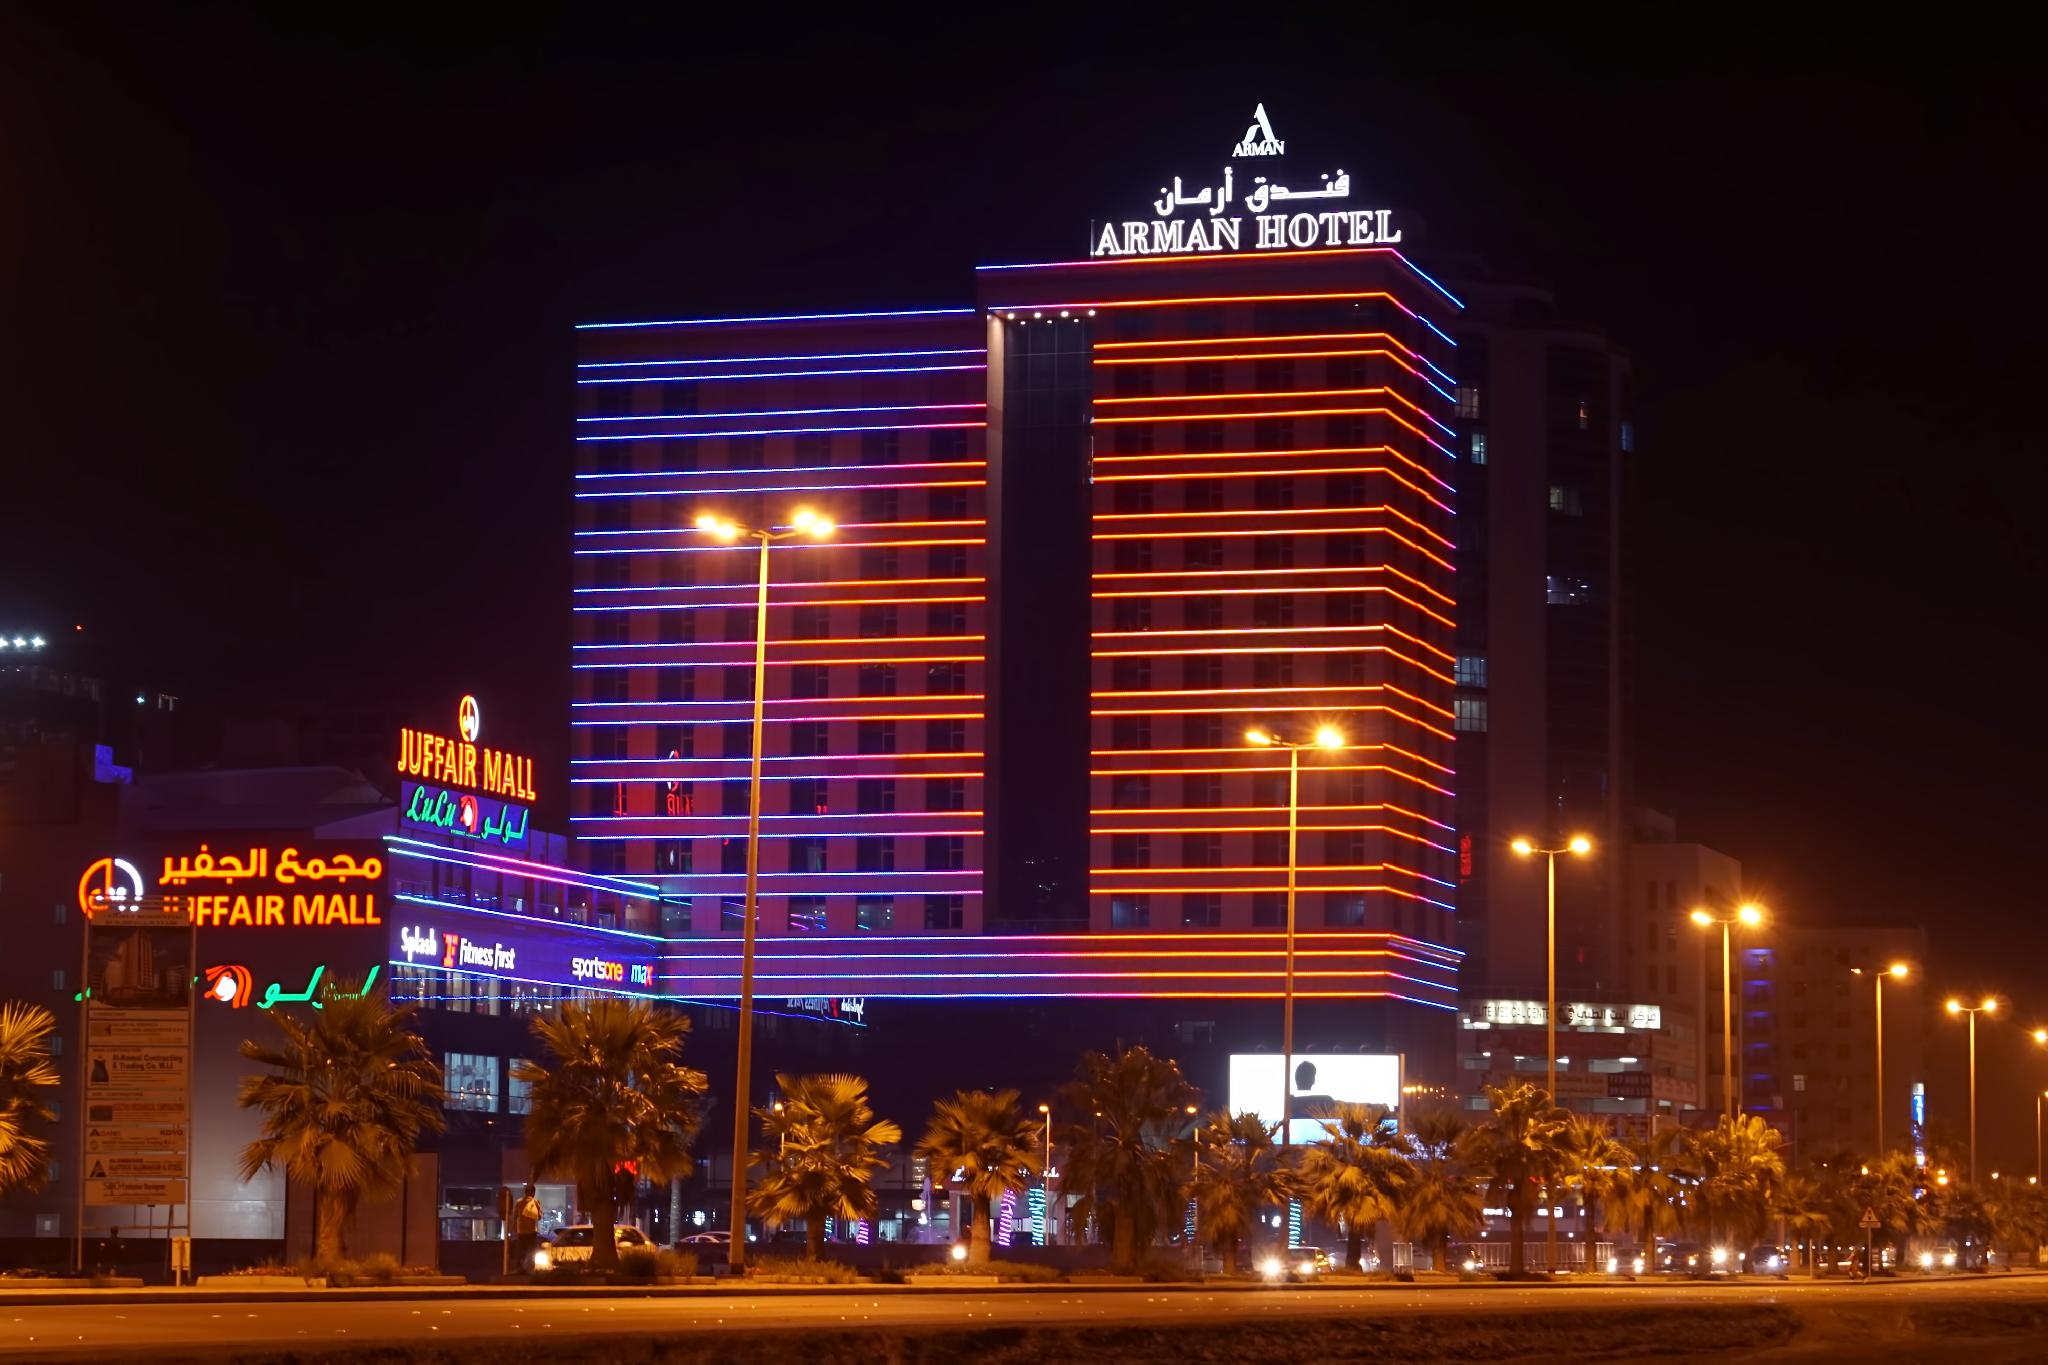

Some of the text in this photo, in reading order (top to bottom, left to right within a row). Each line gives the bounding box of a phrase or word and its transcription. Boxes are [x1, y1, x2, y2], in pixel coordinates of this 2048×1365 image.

[1232, 141, 1285, 157] ARMAN
[1154, 166, 1350, 216] فندق أرمان
[1095, 210, 1401, 256] ARMAN HOTEL
[398, 728, 536, 800] JUFFAIR MALL
[407, 786, 456, 826] LuLu
[481, 805, 529, 843] لولو
[159, 845, 383, 885] مجمع الجفير
[293, 895, 382, 925] MALL
[401, 926, 437, 962] Splash
[572, 957, 623, 981] sportsone
[631, 964, 653, 987] max
